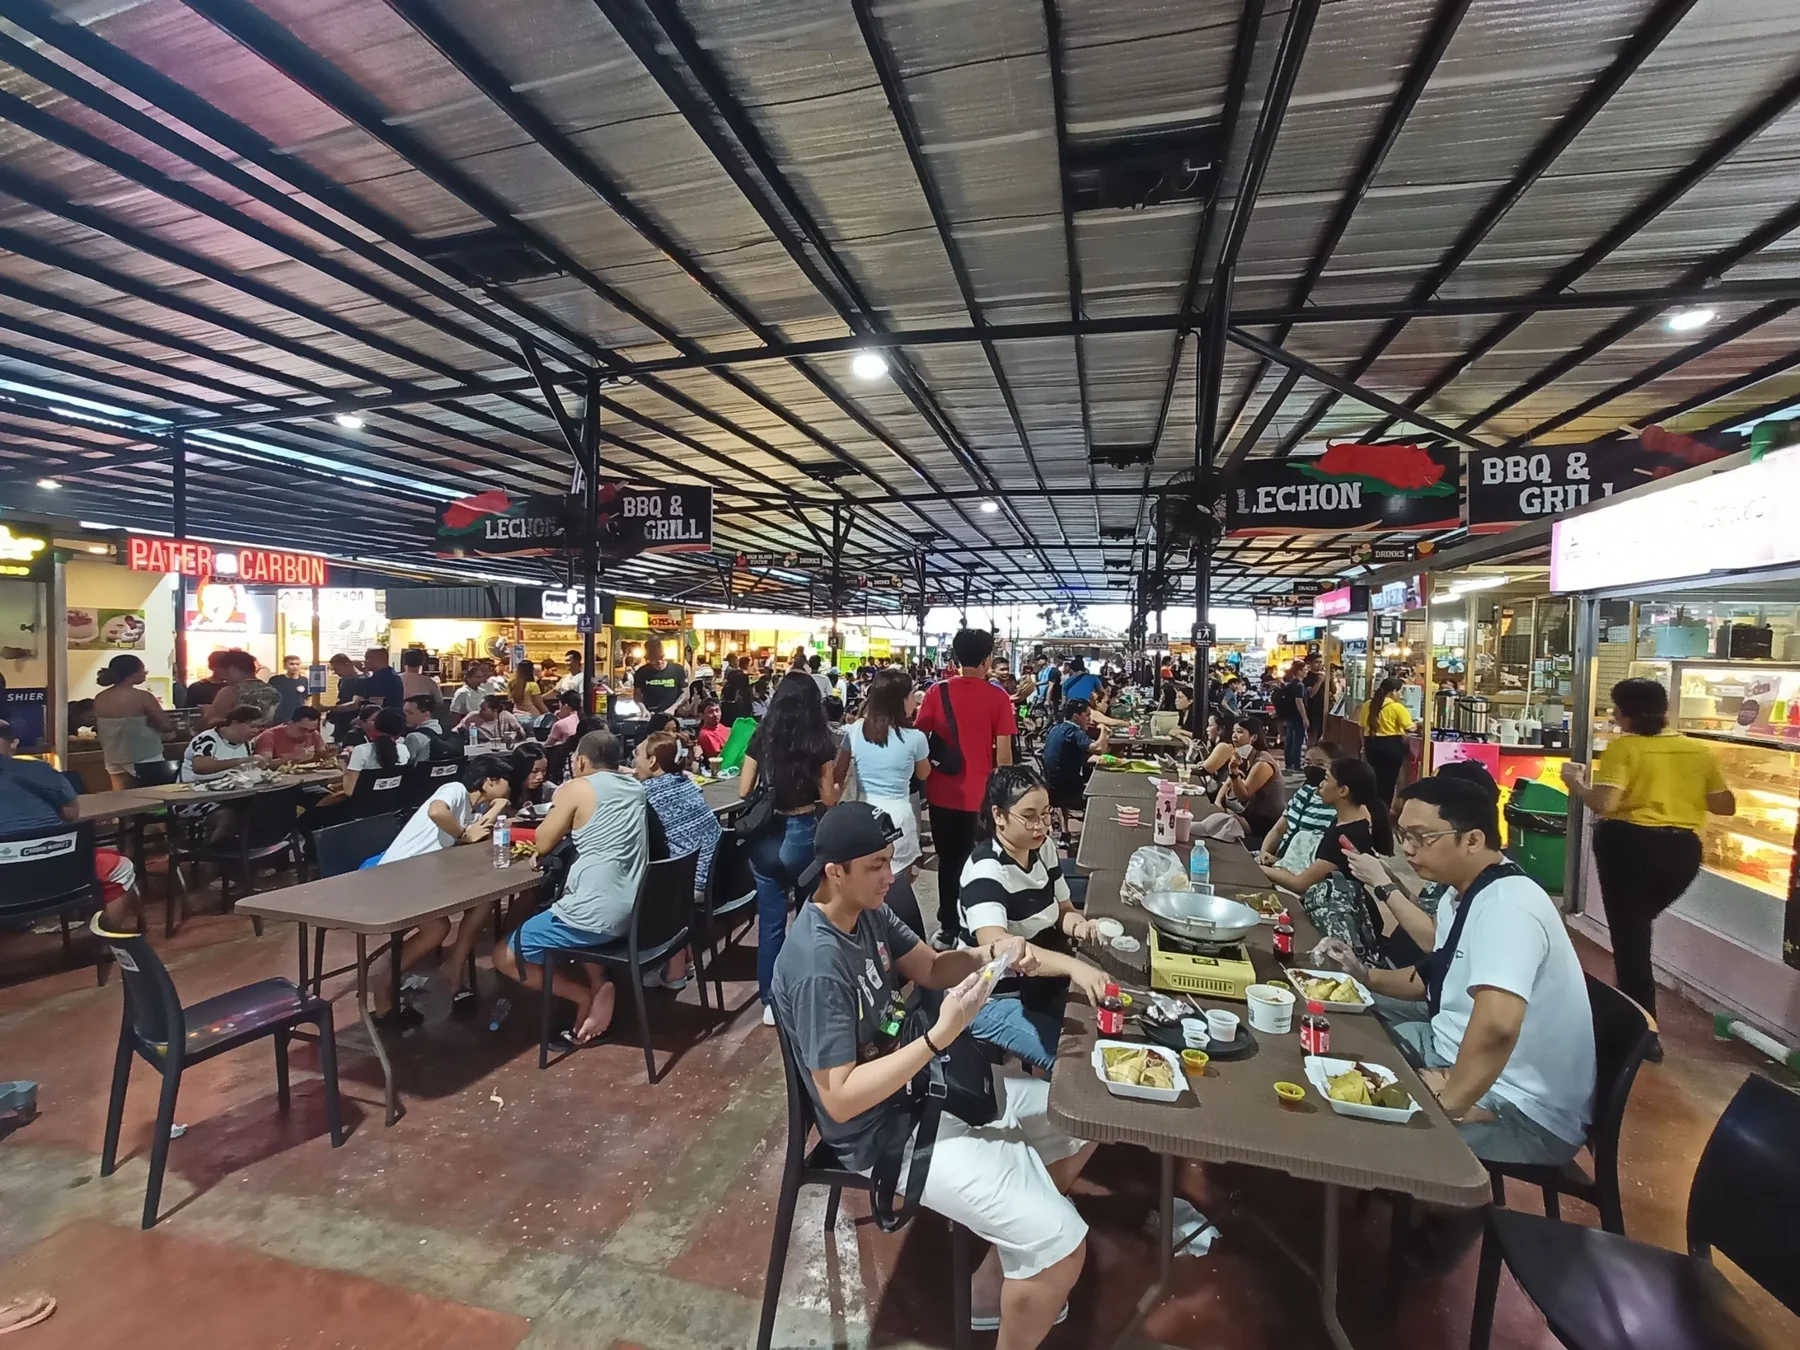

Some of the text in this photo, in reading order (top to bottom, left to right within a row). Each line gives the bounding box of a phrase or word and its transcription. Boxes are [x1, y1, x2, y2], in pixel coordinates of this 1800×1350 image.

[1482, 452, 1591, 485] BBQ &
[622, 495, 684, 517] BBQ &
[1236, 482, 1361, 513] LECHON
[644, 518, 704, 540] GRILL
[131, 538, 325, 586] PATER CARBON
[1374, 549, 1406, 558] DRINKS
[6, 692, 45, 702] SHIER
